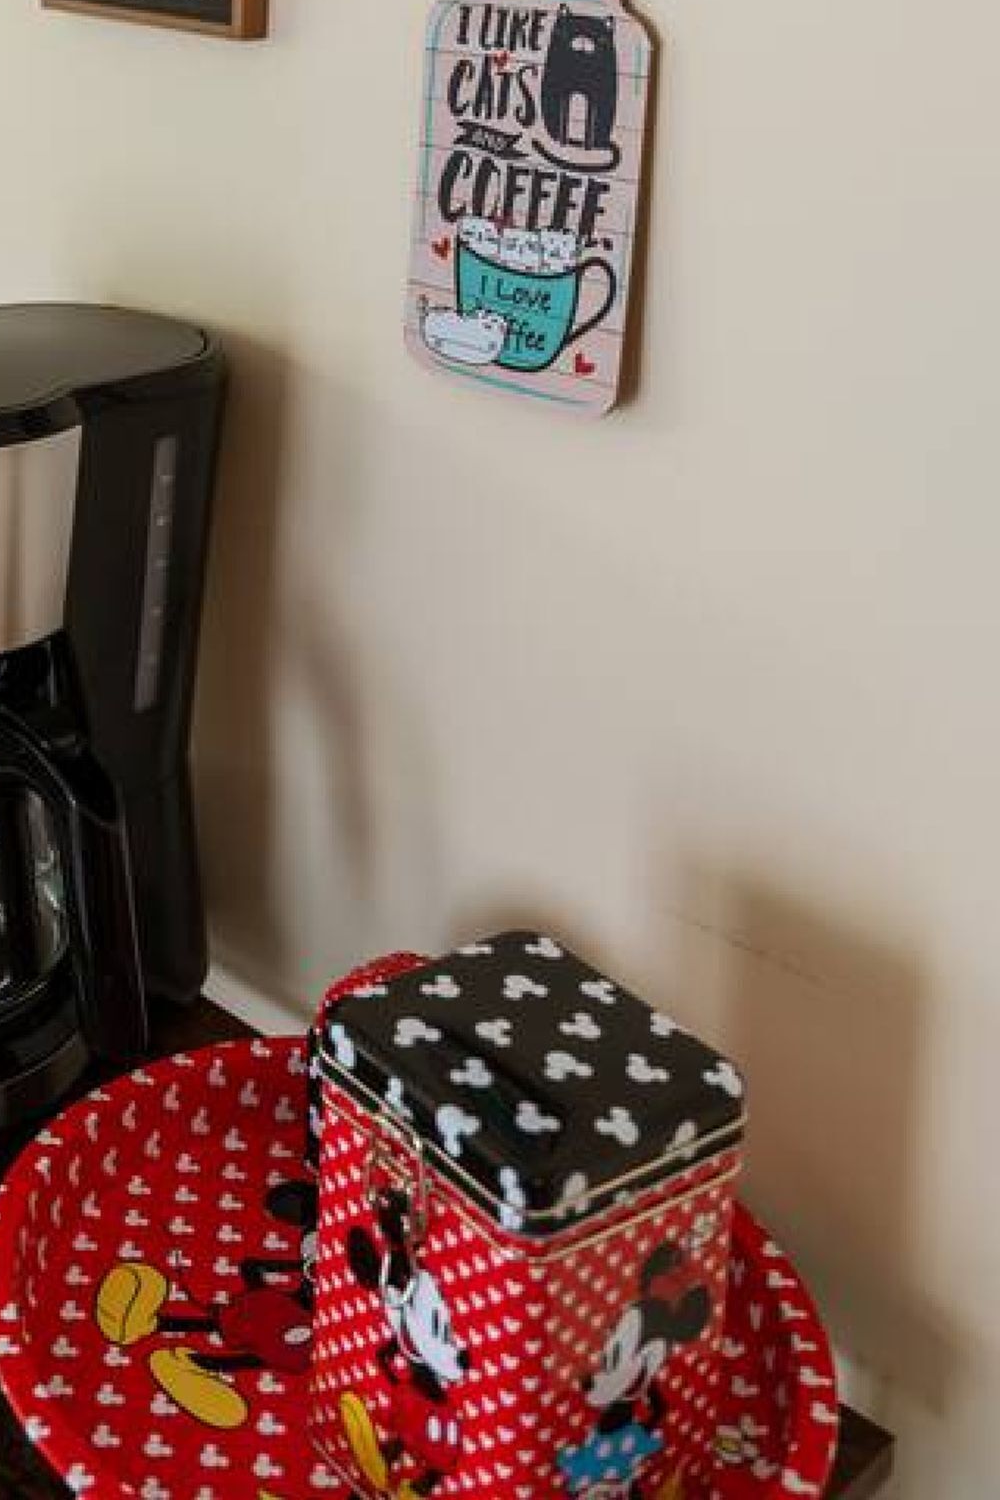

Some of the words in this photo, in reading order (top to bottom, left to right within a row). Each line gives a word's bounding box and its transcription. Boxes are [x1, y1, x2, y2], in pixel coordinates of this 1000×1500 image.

[456, 4, 474, 45] I
[479, 3, 548, 51] LIKE
[447, 53, 539, 129] CATS
[437, 149, 613, 249] COFFEE
